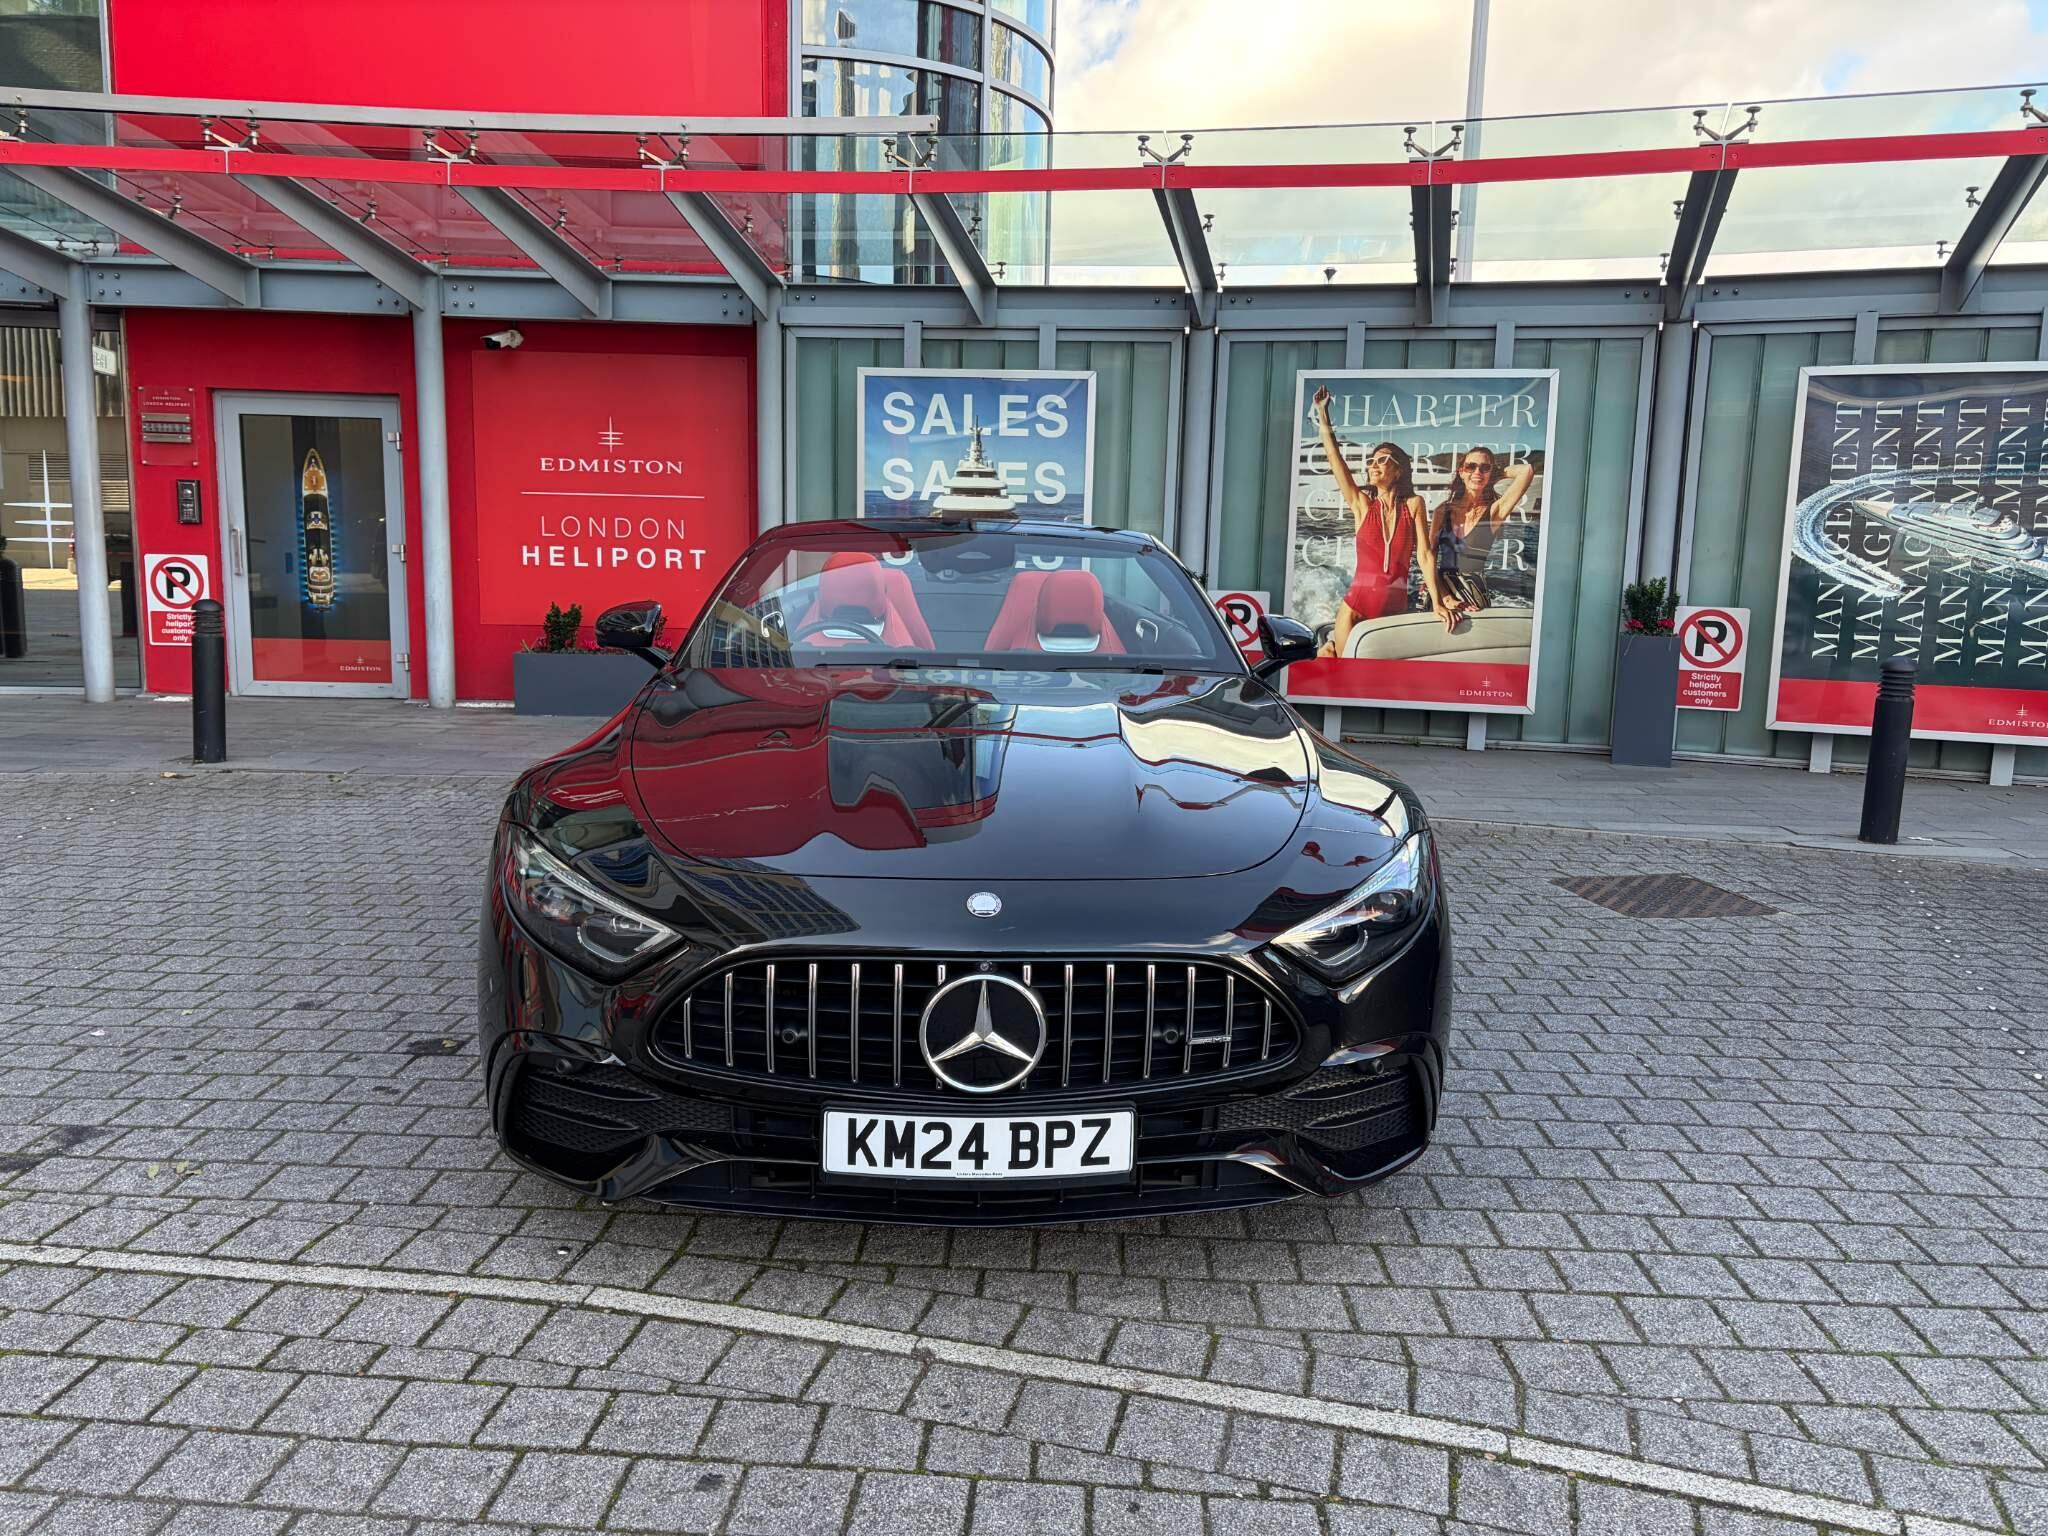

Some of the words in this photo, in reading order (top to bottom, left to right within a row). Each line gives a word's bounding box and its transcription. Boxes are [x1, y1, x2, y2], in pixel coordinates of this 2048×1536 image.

[882, 391, 1069, 438] SALES
[540, 457, 683, 475] EDMISTON
[882, 457, 1067, 505] SAES
[541, 515, 685, 540] LONDON
[522, 545, 706, 570] HELIPORT
[166, 613, 193, 622] Strictly
[172, 635, 189, 643] only
[1691, 672, 1722, 682] Strictly
[1689, 680, 1722, 690] heliport
[1459, 689, 1513, 698] EDMISTON
[1682, 688, 1728, 698] customers
[1694, 697, 1713, 706] only
[1988, 718, 2048, 729] EDMISTO
[847, 1117, 990, 1170] KM24
[1008, 1117, 1113, 1170] BPZ
